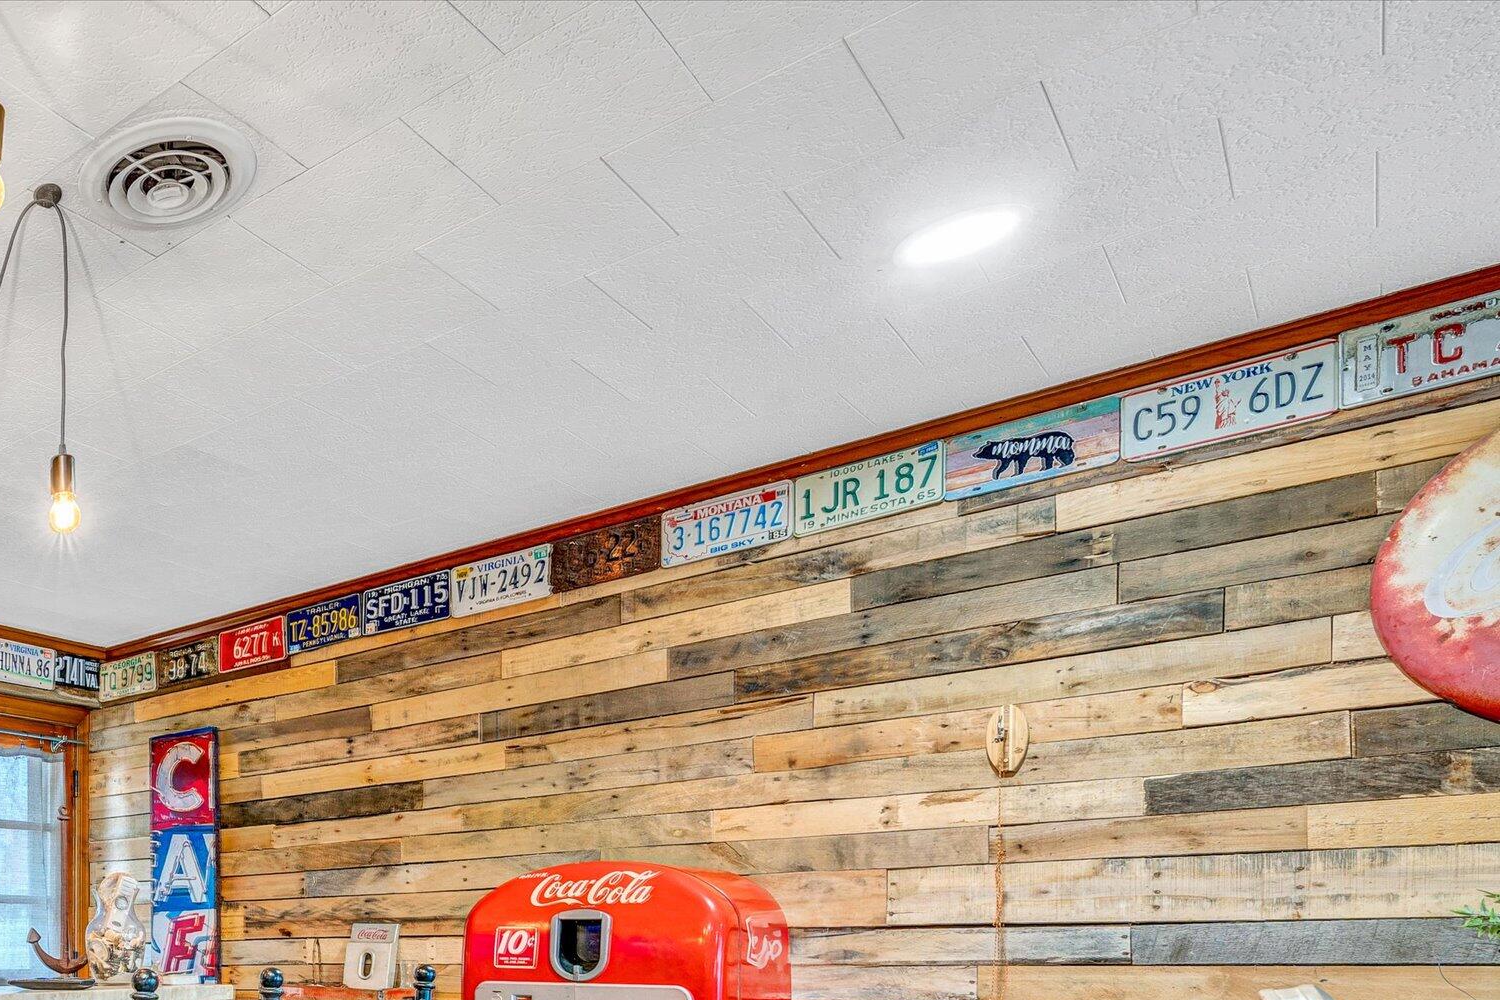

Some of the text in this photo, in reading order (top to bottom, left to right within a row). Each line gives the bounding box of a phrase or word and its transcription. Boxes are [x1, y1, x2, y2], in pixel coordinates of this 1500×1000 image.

[1171, 361, 1273, 398] NEW YORK
[1133, 361, 1325, 441] C59 6DZ
[867, 452, 904, 469] LAKES
[874, 454, 938, 500] 187
[696, 493, 761, 520] MONTANA
[826, 497, 907, 525] MINNESOTA
[916, 488, 937, 500] 65
[710, 544, 728, 553] BIG
[731, 538, 754, 549] SKY
[477, 554, 526, 573] VIRGINIA
[384, 578, 430, 595] MICHIGAN
[456, 559, 546, 603] VJW-2492
[306, 602, 340, 615] TRAILER
[366, 581, 449, 619] SFD-115
[290, 605, 359, 642] TZ-85986
[384, 608, 429, 623] GREAT LAKE
[395, 617, 418, 626] STATE
[233, 632, 270, 659] 6277
[302, 632, 346, 648] PENNSYLVANIA
[9, 644, 39, 656] VIRGINIA
[36, 659, 50, 678] 86
[112, 656, 142, 670] GEORGIA
[121, 662, 152, 687] 9799
[530, 870, 662, 907] Coca-Cola
[357, 929, 389, 940] Coca-Cola
